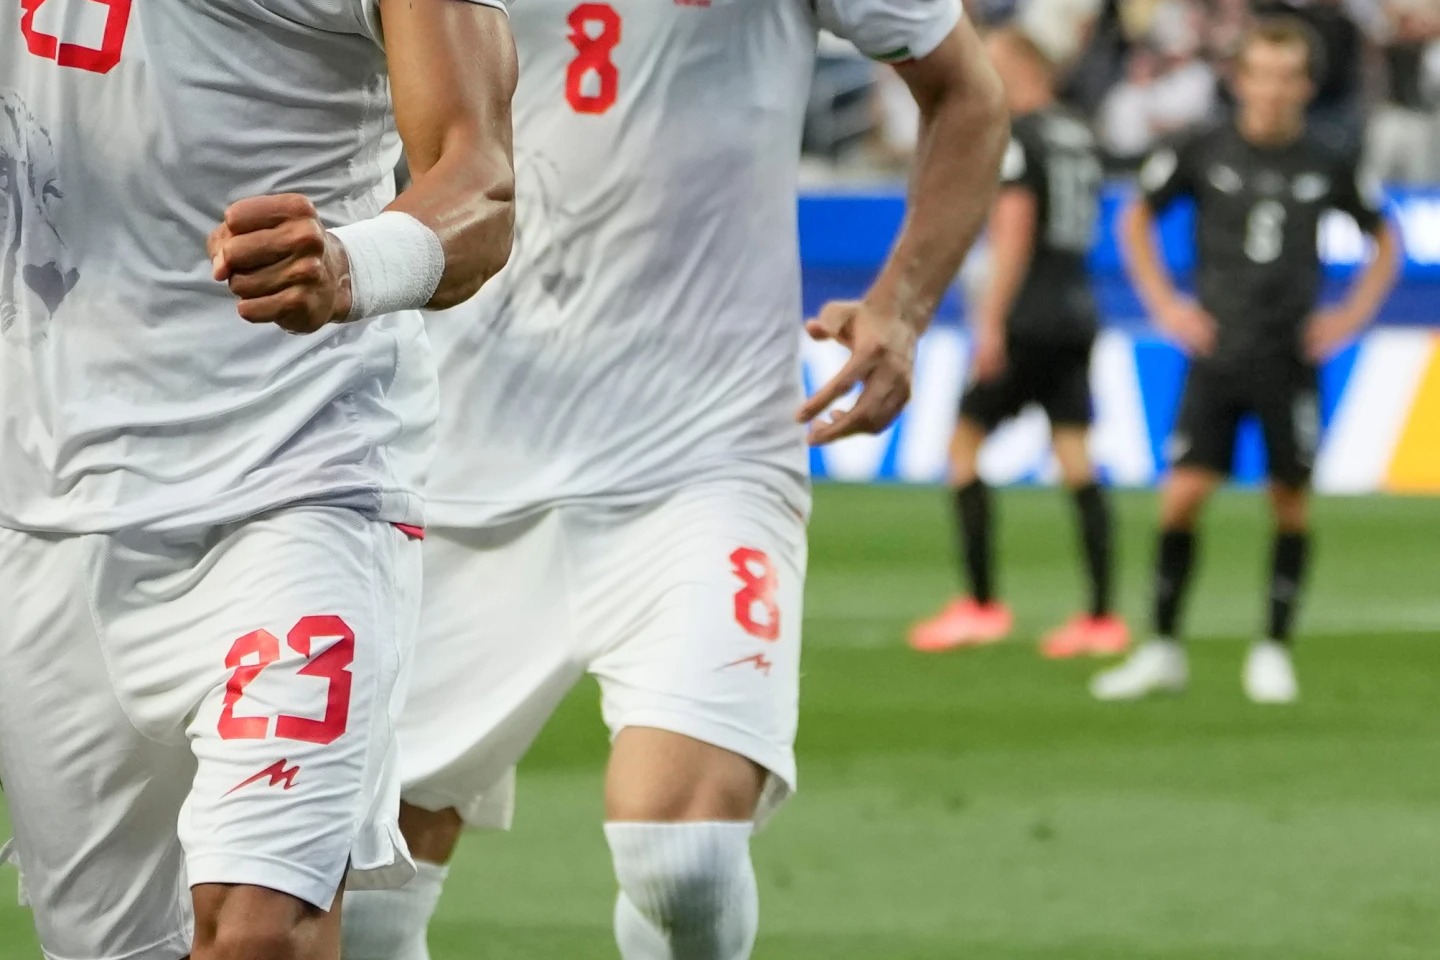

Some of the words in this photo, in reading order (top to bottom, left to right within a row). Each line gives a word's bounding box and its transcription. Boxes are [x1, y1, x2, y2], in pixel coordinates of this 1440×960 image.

[565, 1, 622, 115] 8
[728, 546, 780, 642] 8
[217, 614, 356, 746] 23
